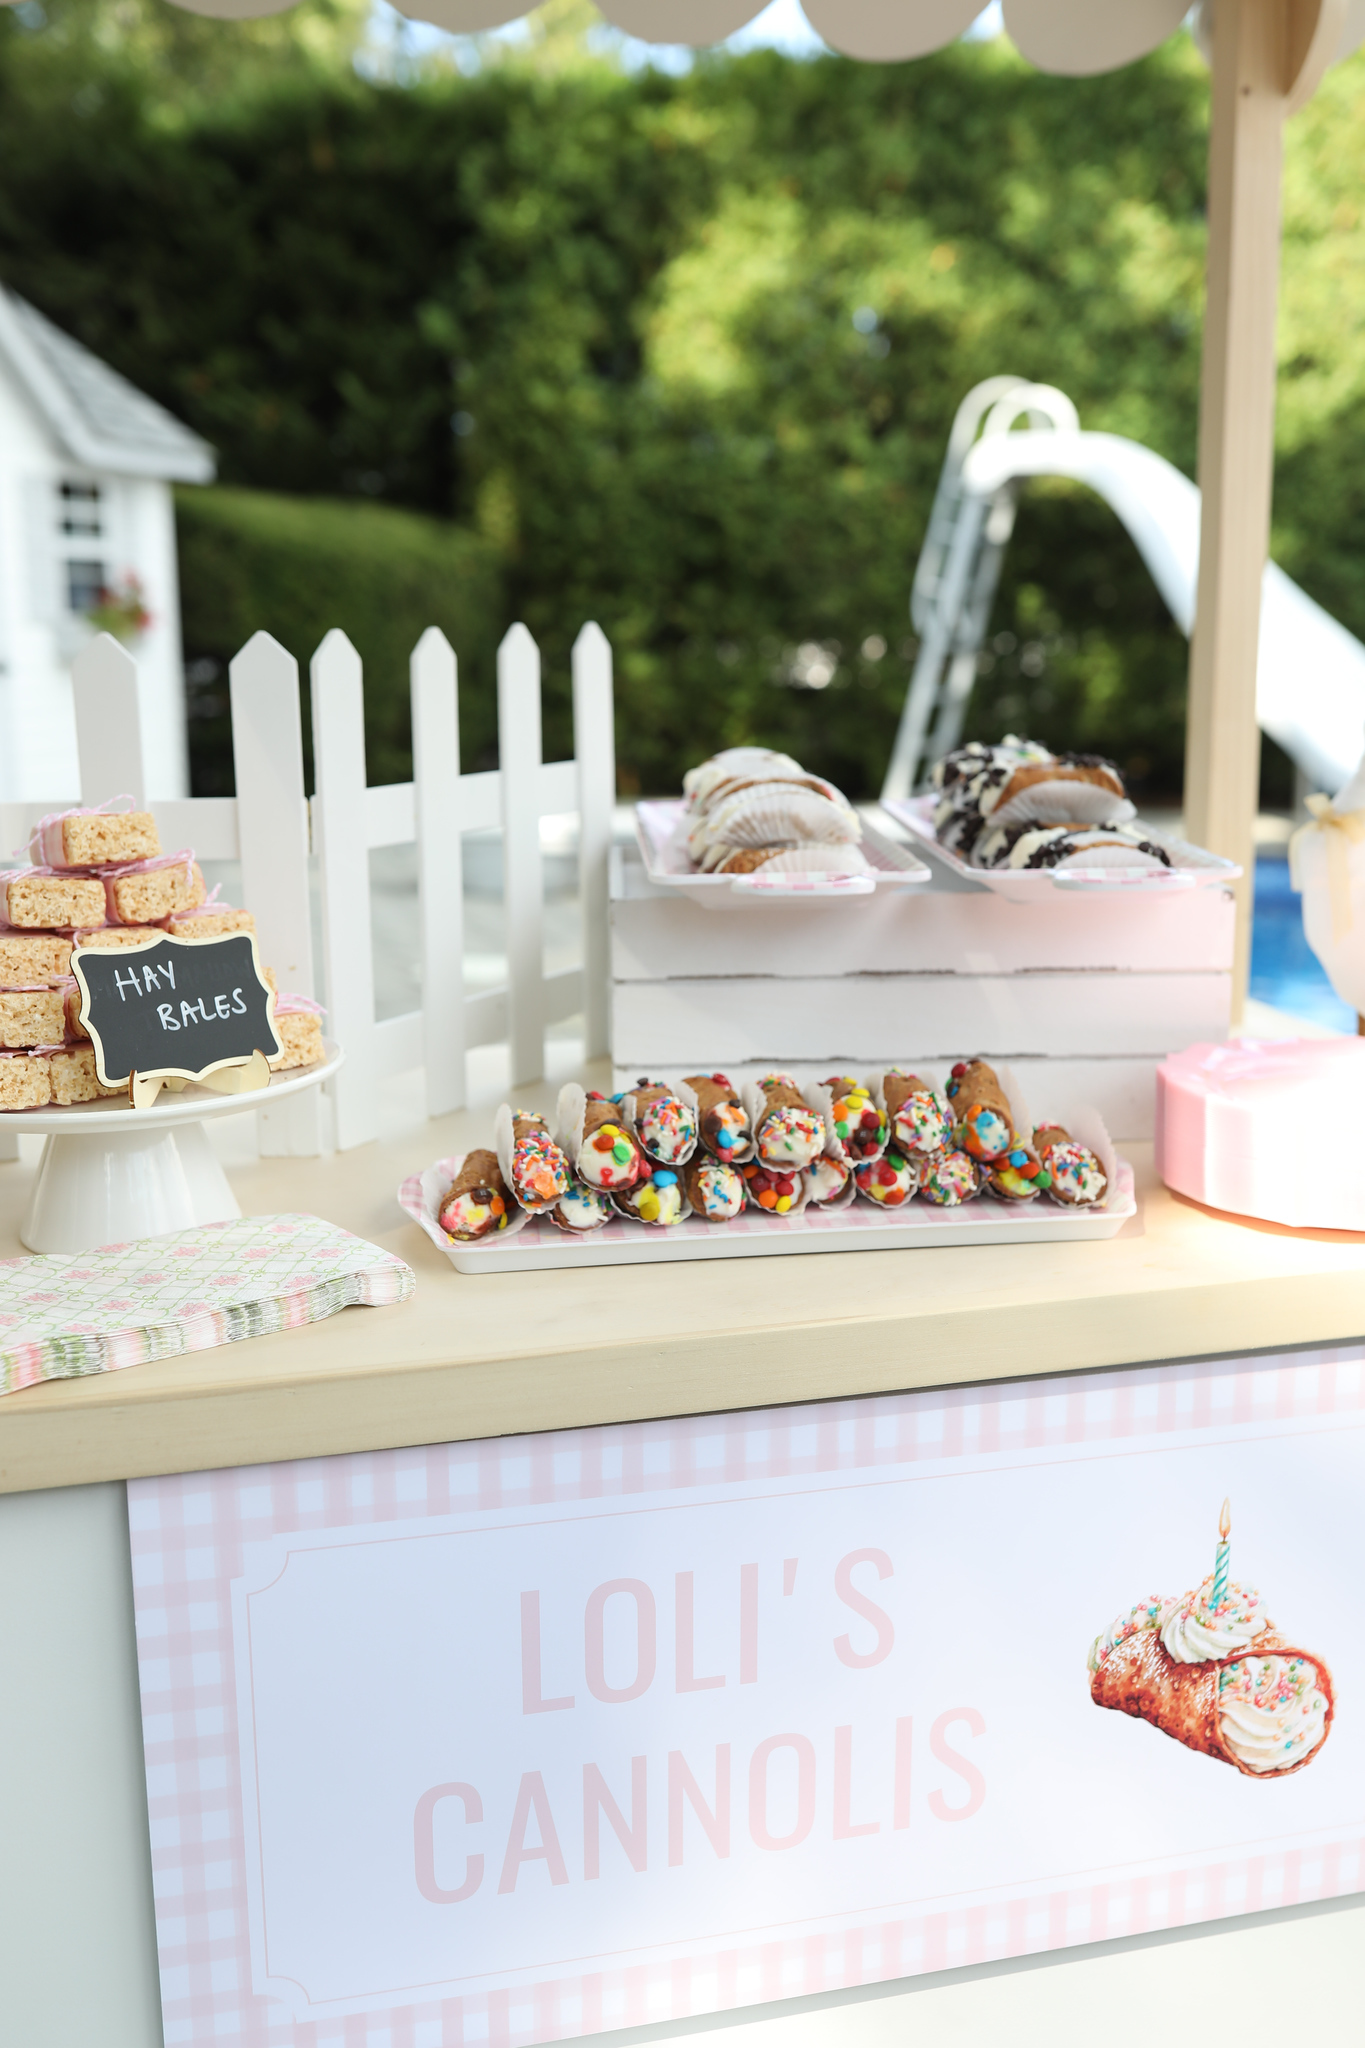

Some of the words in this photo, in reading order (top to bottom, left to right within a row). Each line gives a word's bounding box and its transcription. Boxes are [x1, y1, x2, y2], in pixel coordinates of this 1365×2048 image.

[114, 960, 176, 1001] HAY
[156, 987, 247, 1031] BALES
[520, 1547, 895, 1716] LOLI'S
[413, 1706, 987, 1905] CANNOLIS
